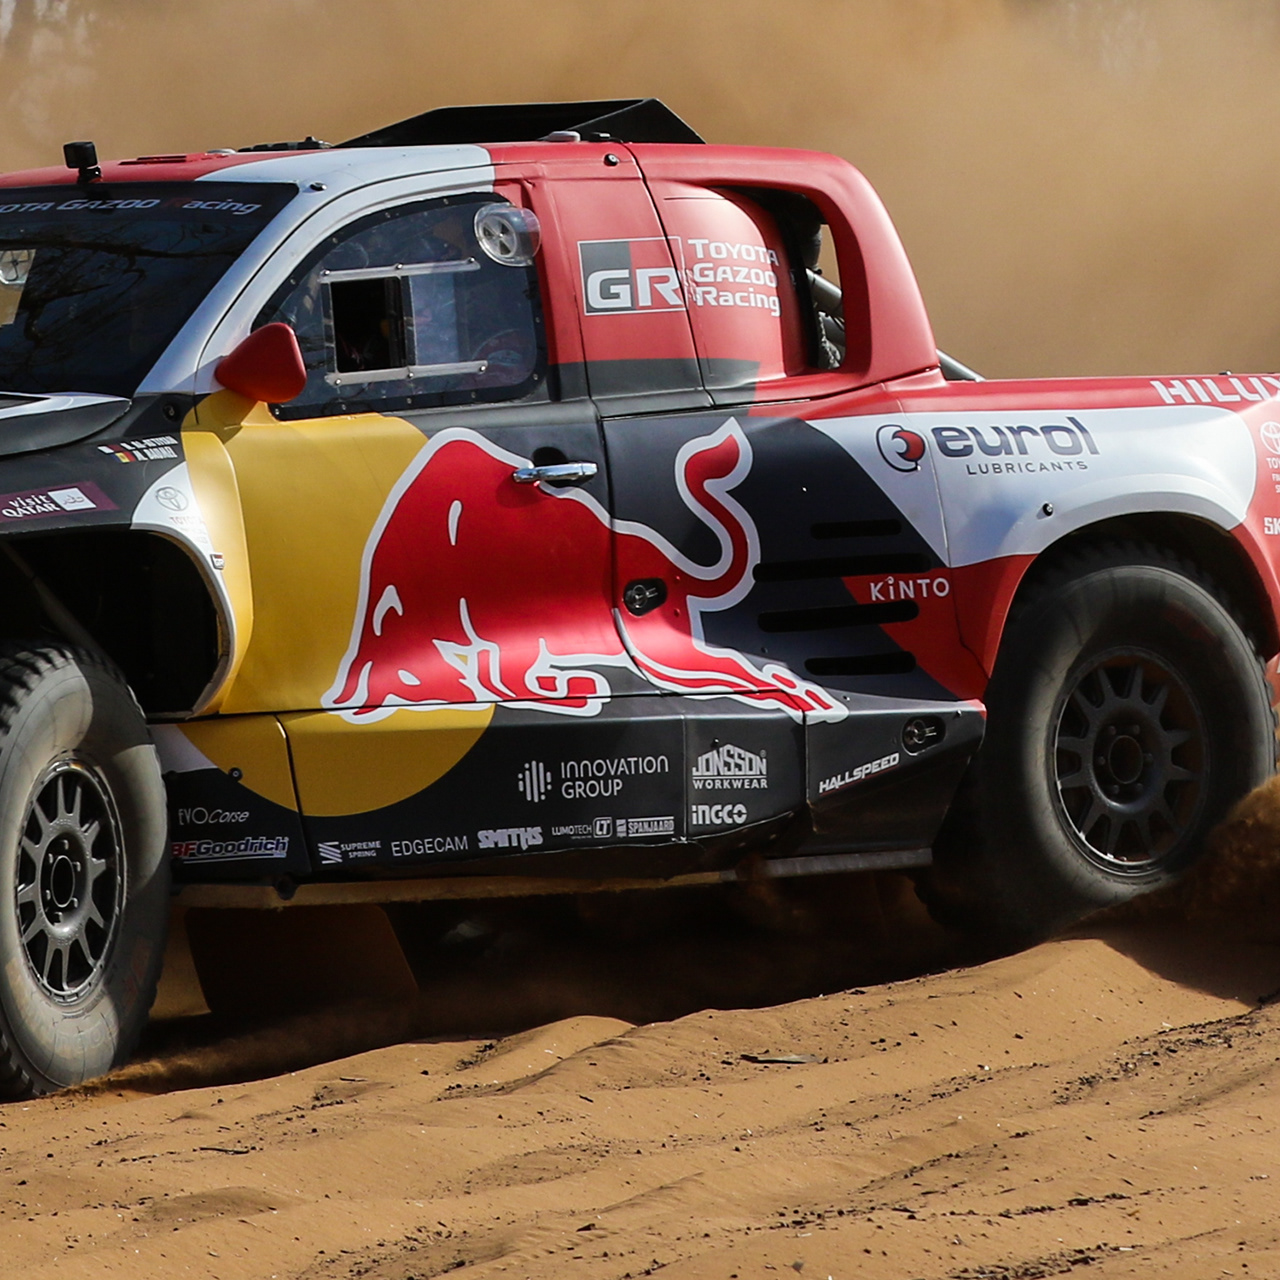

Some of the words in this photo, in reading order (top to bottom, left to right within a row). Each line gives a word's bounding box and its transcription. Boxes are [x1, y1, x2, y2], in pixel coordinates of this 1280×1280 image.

[57, 198, 161, 211] GAZOO
[687, 238, 780, 267] TOYOTA
[692, 262, 778, 288] GAZOO
[586, 266, 684, 309] GR
[695, 286, 781, 317] Racing
[931, 416, 1100, 458] eurol
[966, 460, 1089, 476] LUBRICANTS
[1, 503, 61, 518] QATAR
[8, 494, 51, 508] visit
[561, 755, 669, 778] INNOVATION
[692, 744, 767, 776] JONSSON
[819, 752, 900, 793] HALLSPEED
[561, 779, 623, 799] GROUP
[692, 779, 768, 789] WORKWEAR
[551, 824, 593, 836] LUMOTECH
[628, 820, 674, 834] SPANJAARD
[170, 836, 289, 858] BFGoodrich
[340, 841, 382, 852] SUPREME
[391, 836, 468, 857] EDGECAM
[477, 827, 544, 850] SMITHS
[348, 850, 377, 859] SPRING
